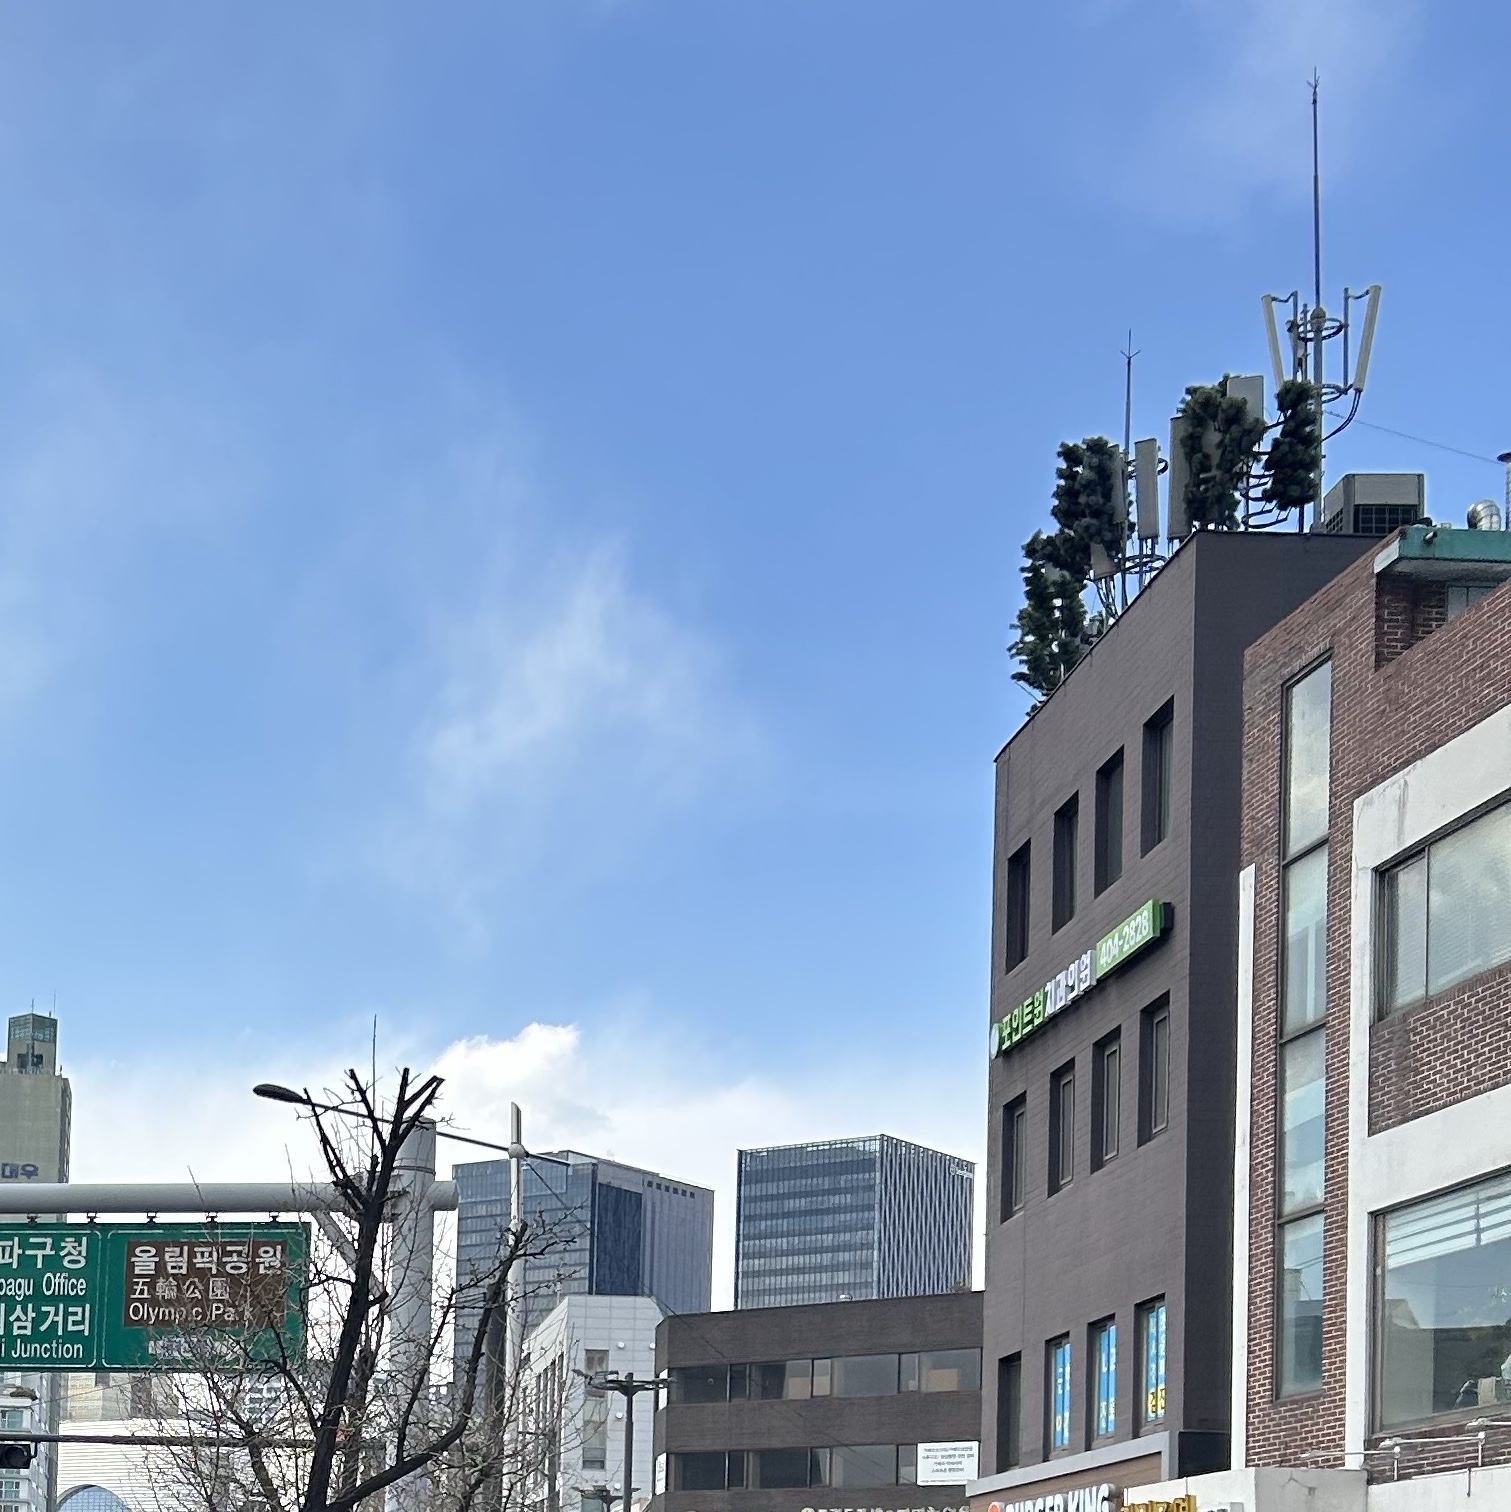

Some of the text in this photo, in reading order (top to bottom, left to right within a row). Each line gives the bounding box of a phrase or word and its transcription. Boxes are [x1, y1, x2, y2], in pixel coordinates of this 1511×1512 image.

[1100, 909, 1149, 967] 404-2828
[0, 1163, 39, 1179] 대우
[130, 1245, 283, 1275] 올림픽공원
[42, 1272, 86, 1296] Office
[11, 1339, 83, 1358] Junction
